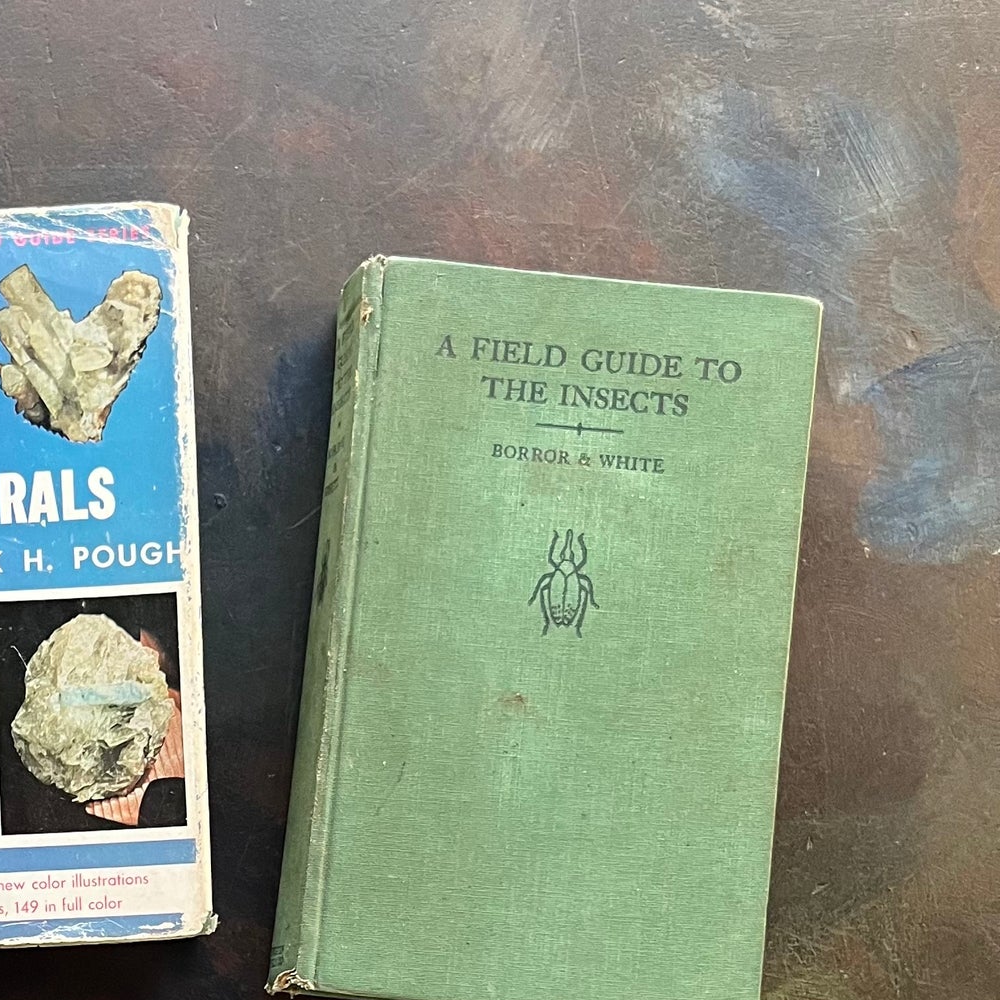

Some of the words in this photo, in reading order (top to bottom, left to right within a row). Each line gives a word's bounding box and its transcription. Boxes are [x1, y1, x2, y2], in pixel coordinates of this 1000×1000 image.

[14, 229, 75, 246] GUIDE
[434, 335, 456, 358] A
[471, 337, 567, 368] FIELD
[581, 348, 683, 379] GUIDE
[695, 357, 742, 384] TO
[481, 375, 548, 405] THE
[559, 385, 689, 418] INSECTS
[492, 443, 570, 465] BORROR
[578, 454, 591, 466] &
[599, 454, 665, 473] WHITE
[24, 550, 53, 572] H.
[73, 542, 185, 569] POUGH
[32, 876, 65, 890] color
[71, 873, 149, 888] illustrations
[14, 901, 38, 914] 149
[44, 899, 56, 912] in
[62, 897, 83, 911] full
[88, 897, 122, 911] color
